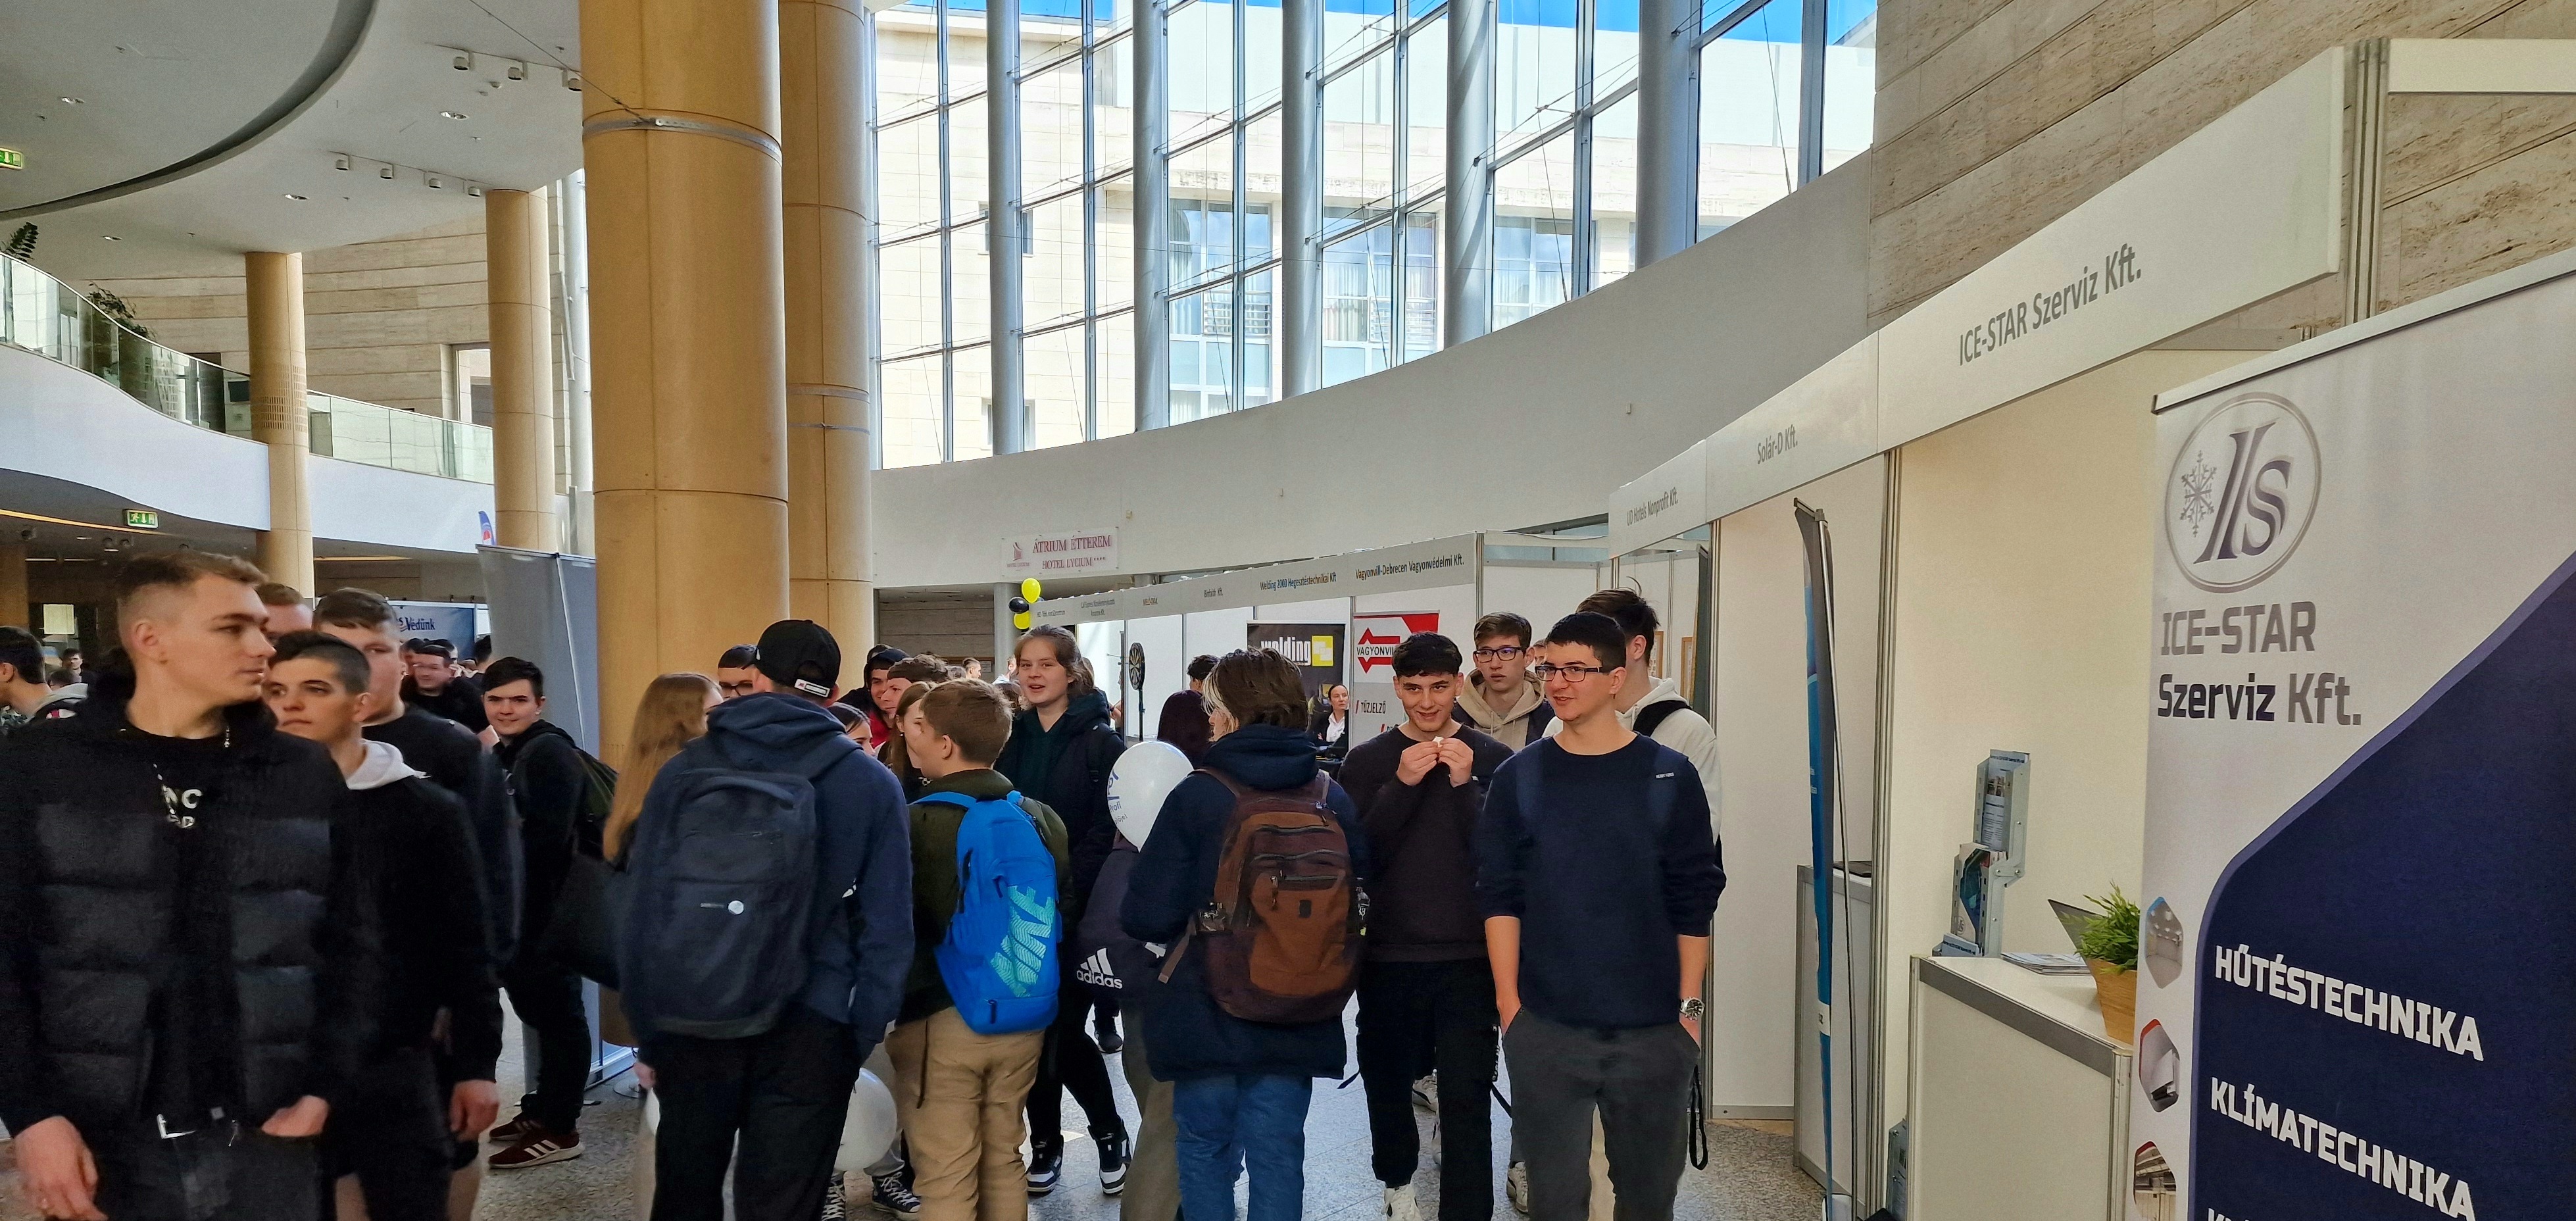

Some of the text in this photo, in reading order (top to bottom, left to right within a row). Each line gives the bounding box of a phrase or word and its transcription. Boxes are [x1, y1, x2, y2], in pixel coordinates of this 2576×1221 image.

[1959, 243, 2141, 366] ICE-STAR Szerviz Kft.
[1757, 424, 1798, 465] Solár-D Kft.
[1670, 486, 1679, 507] Kft.
[1033, 534, 1111, 554] ÁTRIUM ÉTTEREM
[1042, 560, 1064, 570] HOTEL
[1066, 557, 1092, 568] LYCIUM
[1355, 553, 1464, 581] Vagyonvill-Debrecen Vagyonvédelmi Kft.
[1260, 580, 1277, 591] Welding
[2160, 600, 2316, 656] ICE-STAR
[1361, 700, 1386, 714] TŰZJELZŐ
[2157, 672, 2362, 726] Szerviz Kft.
[1076, 969, 1124, 989] adidas
[2215, 943, 2484, 1062] HŰTÉSTECHNIKA
[2210, 1076, 2476, 1221] KLÍMATECHNIKA
